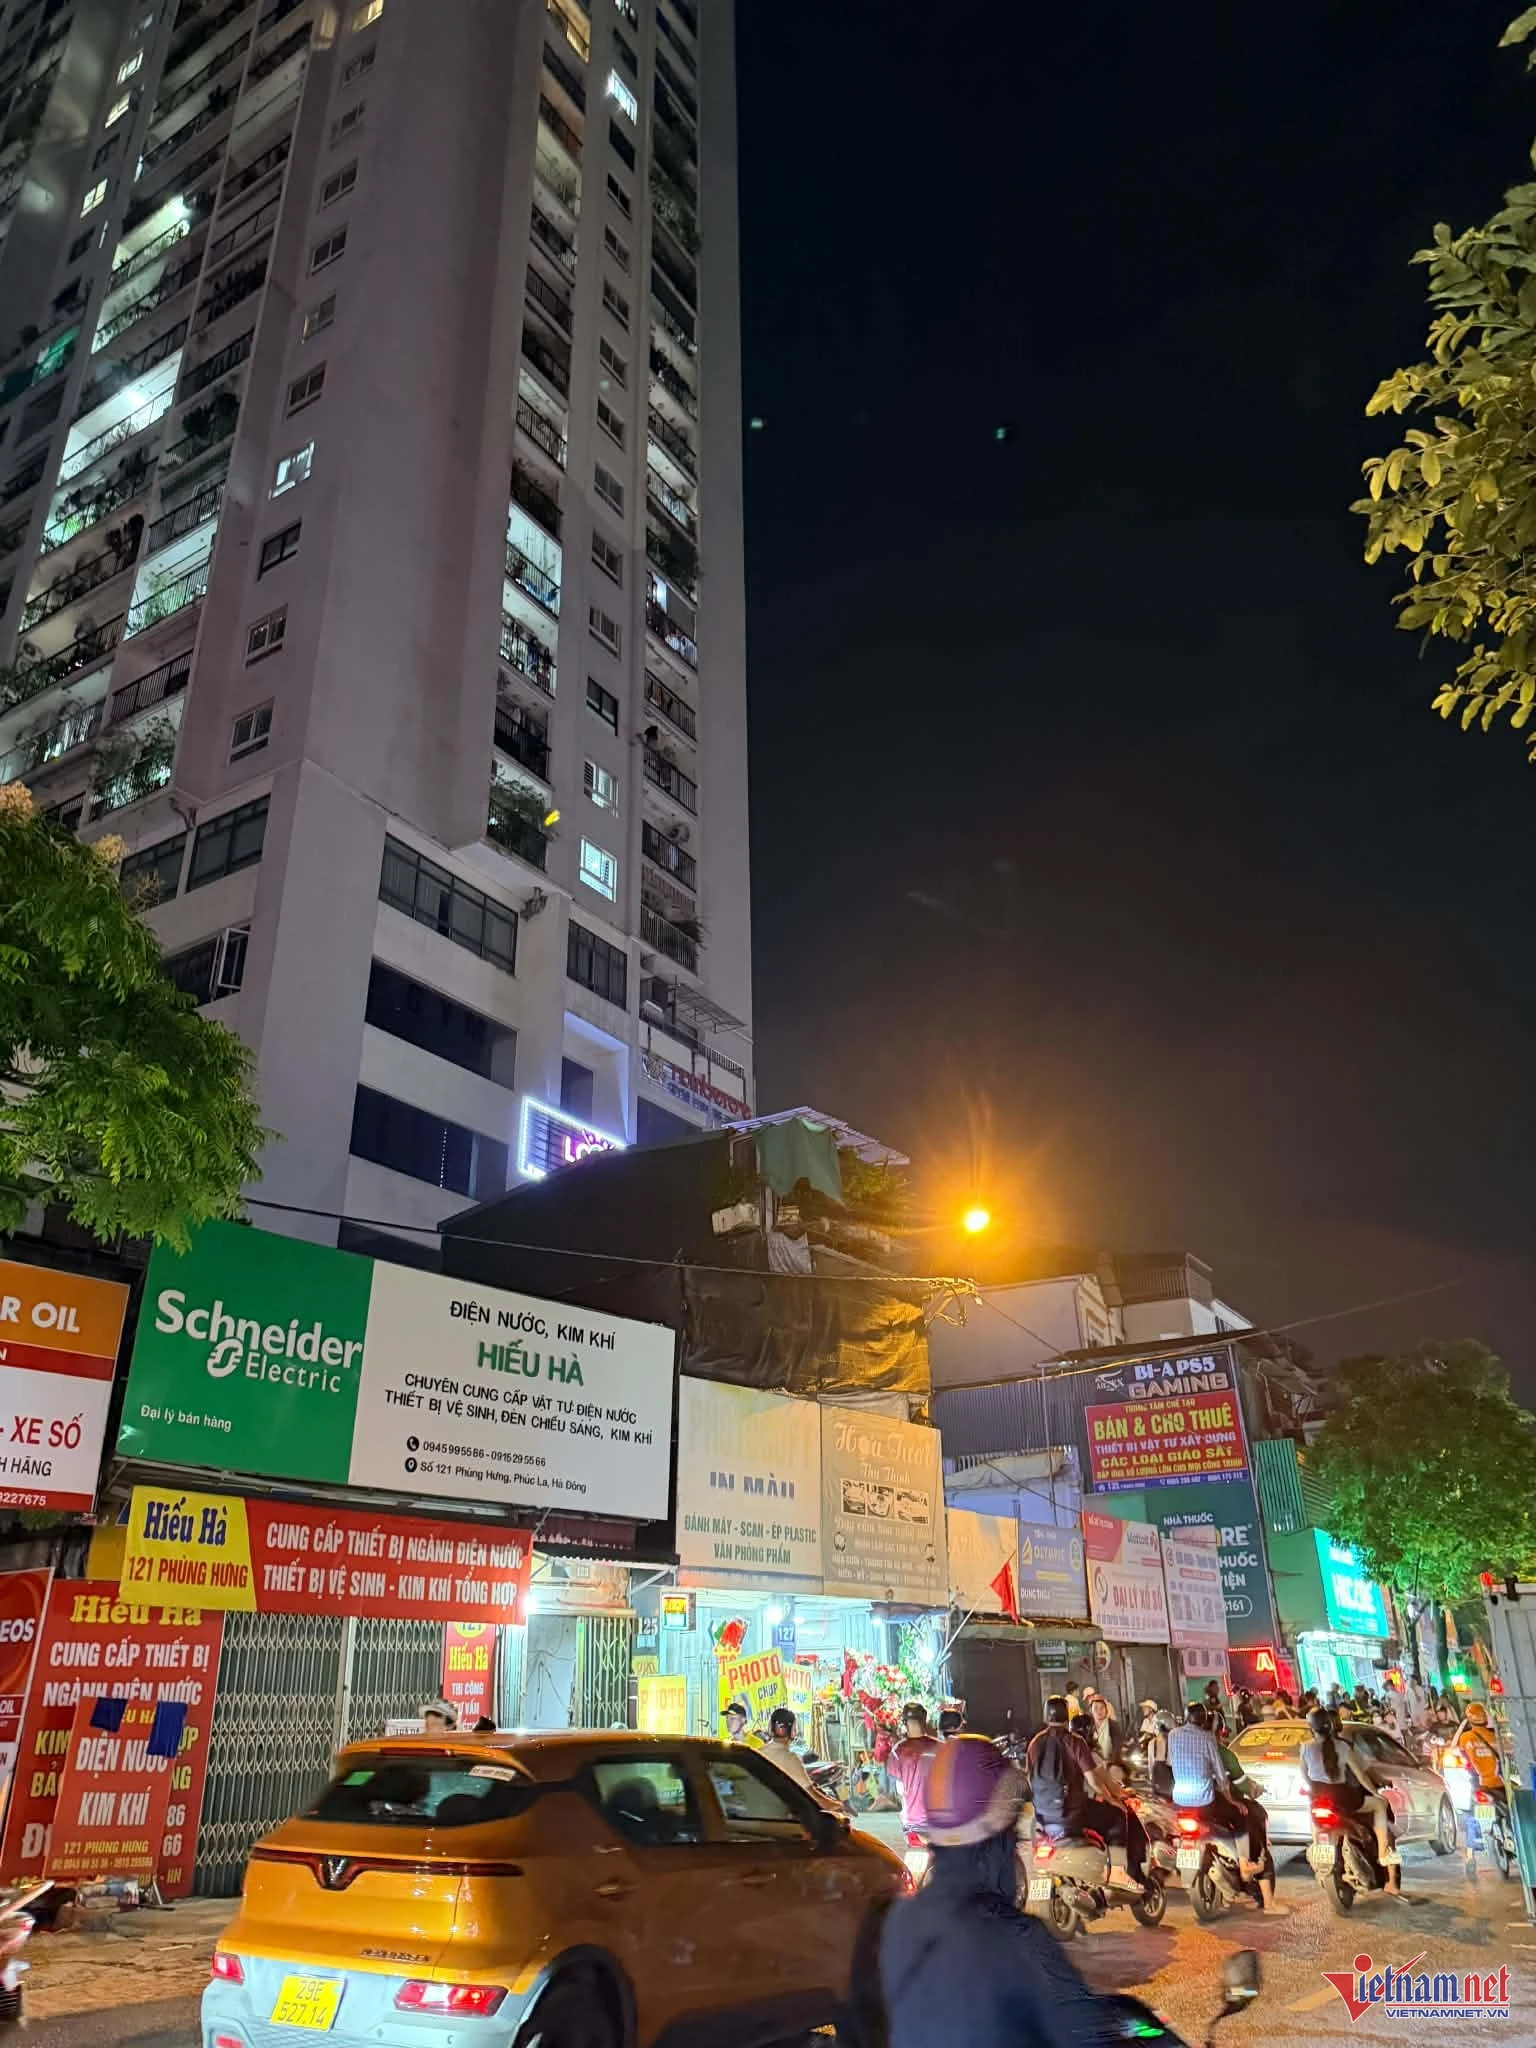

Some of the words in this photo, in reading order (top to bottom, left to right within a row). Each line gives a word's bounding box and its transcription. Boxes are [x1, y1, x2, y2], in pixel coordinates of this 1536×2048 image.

[31, 1301, 80, 1333] OIL
[155, 1289, 363, 1369] Schneider
[450, 1300, 490, 1326] ĐIỆN
[497, 1311, 549, 1339] NƯỚC,
[556, 1323, 584, 1345] KIM
[589, 1325, 615, 1351] KHÍ
[245, 1353, 341, 1393] Electric
[477, 1339, 540, 1378] HIẾU
[548, 1353, 584, 1387] HÀ
[1176, 1356, 1216, 1375] PS5
[404, 1373, 459, 1396] CHUYÊN
[462, 1383, 499, 1402] CUNG
[503, 1385, 529, 1408] CẤP
[532, 1393, 552, 1411] VẬT
[576, 1400, 602, 1422] ĐIỆN
[605, 1407, 638, 1425] NƯỚC
[1128, 1372, 1229, 1399] GAMING
[9, 1415, 44, 1446] XE
[48, 1411, 84, 1450] SỐ
[141, 1404, 161, 1421] Đại
[165, 1408, 175, 1425] lý
[178, 1410, 200, 1427] bán
[203, 1413, 232, 1433] hàng
[385, 1389, 423, 1410] THIẾT
[429, 1398, 442, 1416] BỊ
[446, 1398, 464, 1417] VỆ
[466, 1403, 498, 1425] SINH,
[501, 1407, 526, 1427] ĐÈN
[531, 1413, 566, 1433] CHIẾU
[569, 1418, 604, 1442] SÁNG,
[610, 1427, 630, 1443] KIM
[634, 1430, 653, 1446] KHÍ
[1094, 1416, 1128, 1441] BÁN
[1135, 1418, 1146, 1436] &
[1151, 1413, 1185, 1435] CHO
[1187, 1402, 1234, 1431] THUÊ
[11, 1456, 52, 1477] HÃNG
[420, 1460, 434, 1473] Số
[436, 1464, 451, 1474] 121
[143, 1496, 195, 1543] Hiếu
[198, 1505, 228, 1546] Hà
[684, 1513, 710, 1532] ĐÁNH
[712, 1516, 732, 1535] MÁY
[740, 1520, 764, 1539] SCAN
[771, 1521, 784, 1540] ÉP
[784, 1524, 817, 1544] PLASTIC
[266, 1521, 310, 1551] CUNG
[313, 1519, 344, 1553] CẤP
[347, 1524, 386, 1558] THIẾT
[388, 1536, 405, 1565] BỊ
[406, 1533, 453, 1564] NGÀNH
[456, 1541, 487, 1571] ĐIỆN
[714, 1541, 733, 1559] VĂN
[128, 1555, 154, 1582] 121
[211, 1561, 248, 1588] HƯNG
[263, 1558, 306, 1592] THIẾT
[308, 1566, 325, 1599] BỊ
[328, 1561, 347, 1601] VỆ
[350, 1570, 386, 1597] SINH
[398, 1575, 425, 1600] KIM
[428, 1576, 452, 1602] KHÍ
[454, 1569, 488, 1604] TỔNG
[491, 1580, 517, 1610] HỢP
[639, 1616, 659, 1636] 125
[778, 1627, 795, 1642] 127
[50, 1641, 101, 1667] CUNG
[104, 1635, 141, 1668] CẤP
[144, 1636, 191, 1669] THIẾT
[192, 1642, 210, 1674] BỊ
[728, 1653, 782, 1692] PHOTO
[75, 1731, 121, 1780] ĐIỆN
[77, 1791, 117, 1827] KIM
[117, 1785, 152, 1827] KHÍ
